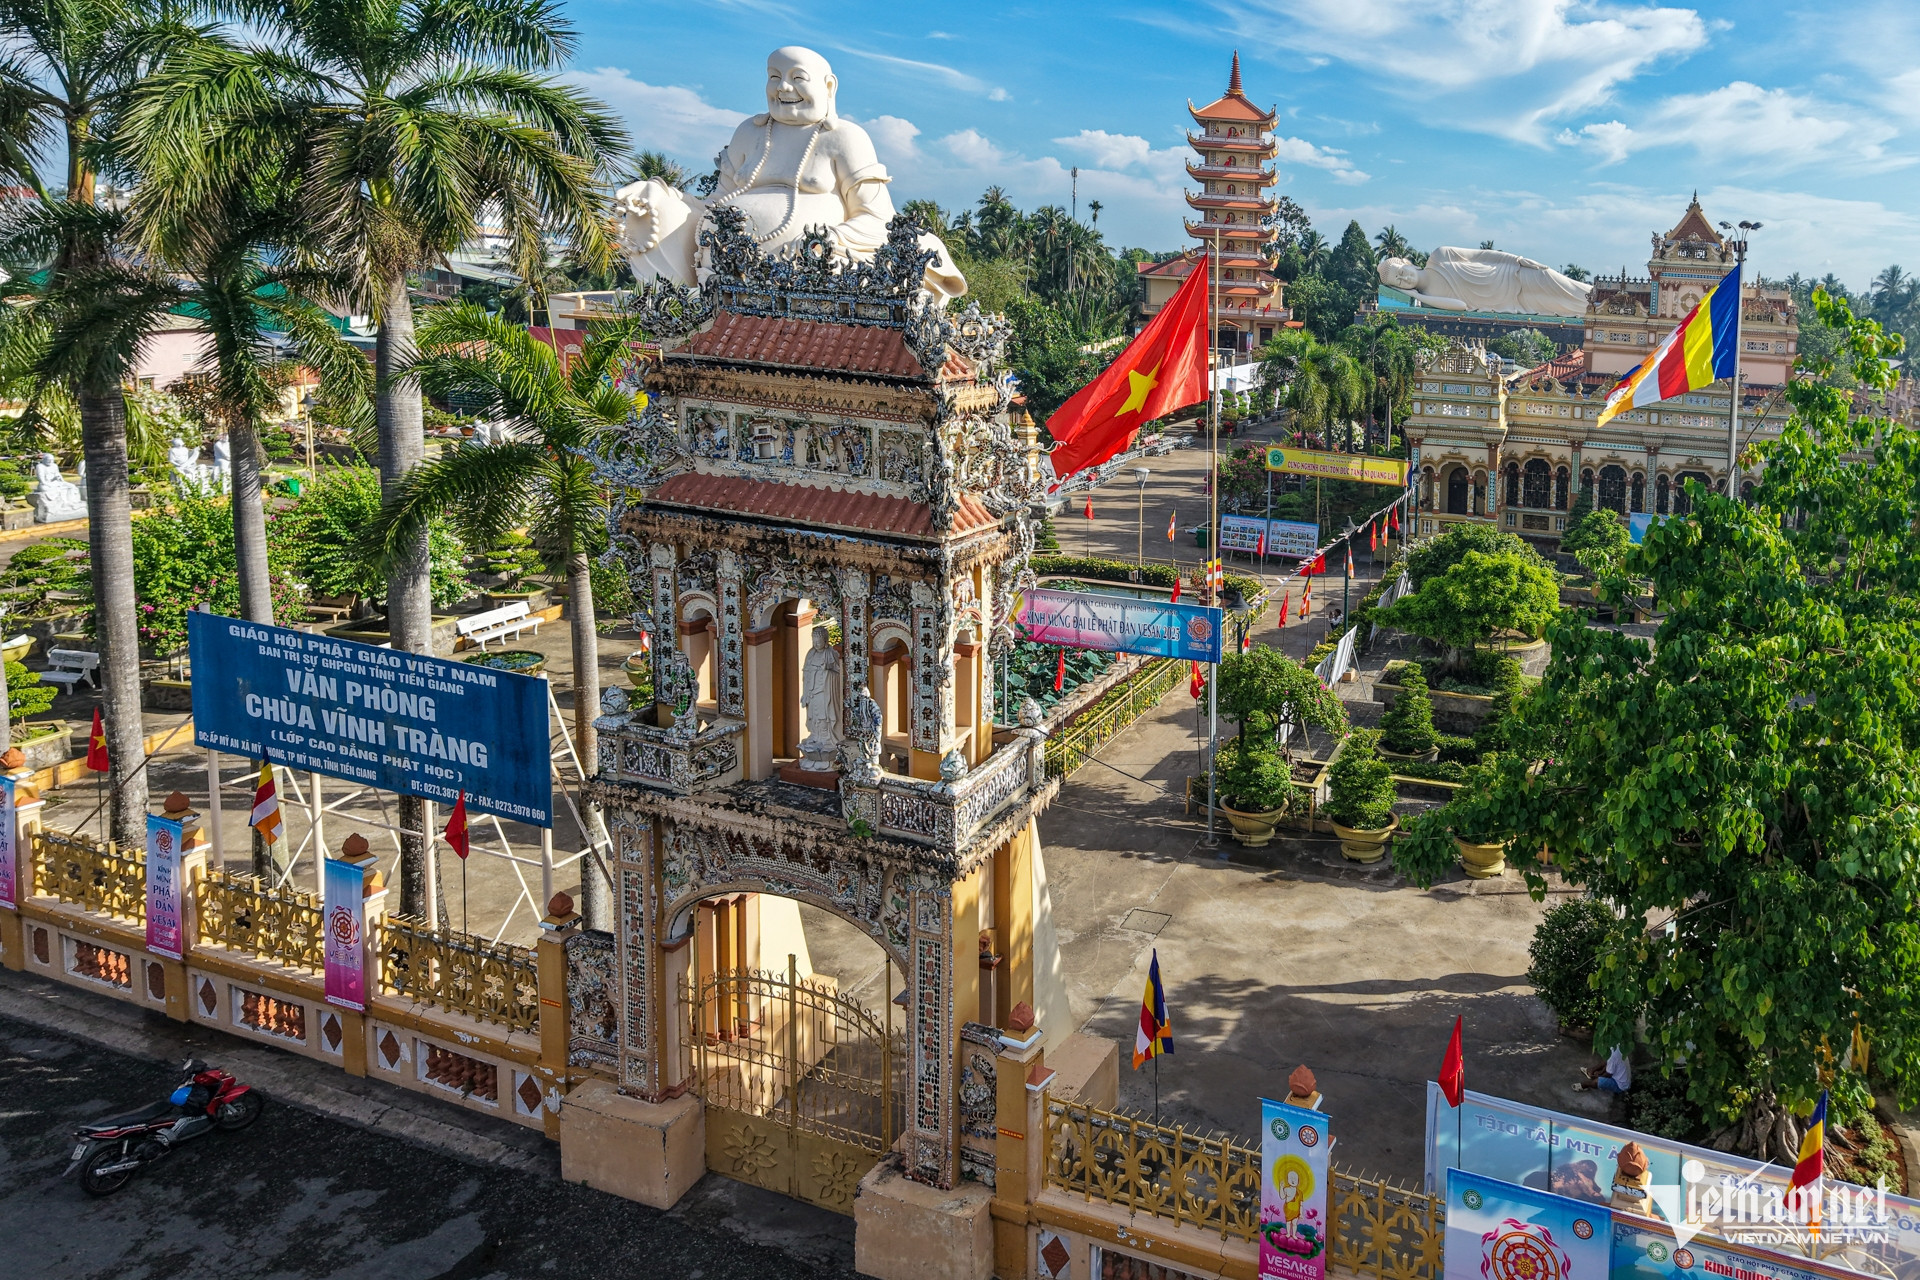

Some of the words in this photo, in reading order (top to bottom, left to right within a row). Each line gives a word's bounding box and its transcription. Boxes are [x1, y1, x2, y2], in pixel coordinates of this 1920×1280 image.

[229, 625, 268, 642] GIÁO
[274, 633, 303, 650] HỘI
[308, 640, 352, 660] PHẬT
[358, 650, 401, 668] GIÁO
[406, 659, 446, 679] VIỆT
[451, 668, 497, 688] NAM
[1138, 623, 1161, 639] VESAK
[1163, 626, 1180, 641] 2025
[258, 645, 281, 658] BAN
[283, 649, 301, 664] TRỊ
[303, 653, 319, 668] SỰ
[321, 658, 366, 676] GHPGVN
[369, 665, 396, 682] TỈNH
[428, 678, 465, 696] GIANG
[285, 666, 338, 701] VĂN
[345, 680, 436, 723] PHÒNG
[245, 693, 316, 731] CHÙA
[321, 706, 386, 747] VĨNH
[393, 724, 488, 769] TRÀNG
[279, 729, 305, 745] LỚP
[308, 737, 336, 753] CAO
[338, 742, 379, 763] ĐẲNG
[382, 753, 420, 772] PHẬT
[424, 763, 455, 781] HỌC
[230, 737, 240, 749] AN
[287, 751, 296, 762] TP
[355, 767, 377, 782] GIANG
[478, 795, 494, 809] FAX:
[495, 800, 531, 819] 0273.3978
[531, 808, 546, 821] 660
[1265, 1253, 1308, 1275] VESAK
